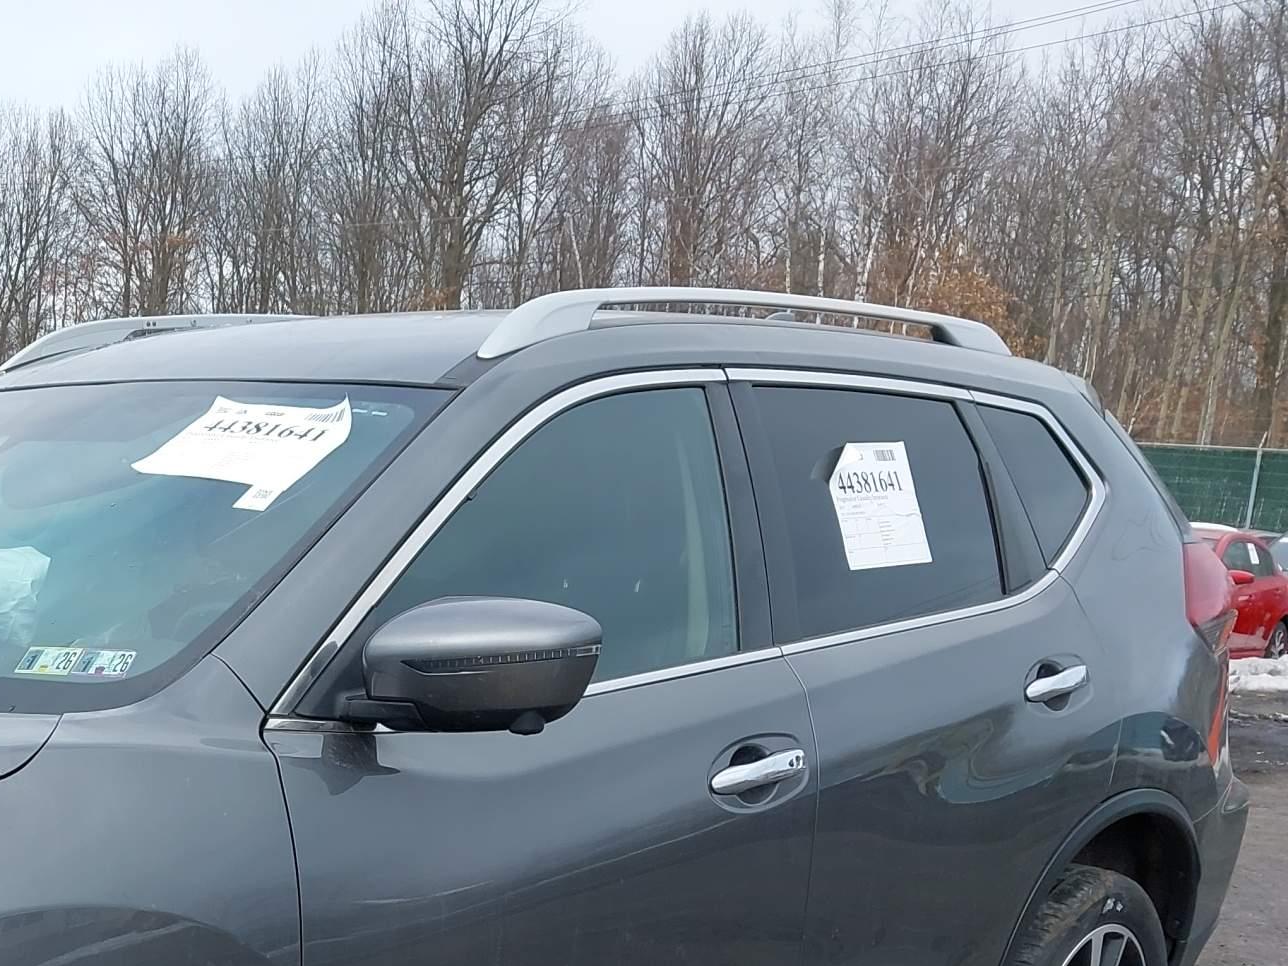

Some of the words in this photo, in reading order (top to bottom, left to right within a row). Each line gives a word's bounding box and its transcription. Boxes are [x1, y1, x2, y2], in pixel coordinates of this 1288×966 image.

[204, 419, 329, 442] 44381641
[837, 470, 904, 494] 44381641
[55, 651, 77, 670] 26
[111, 653, 133, 673] 26
